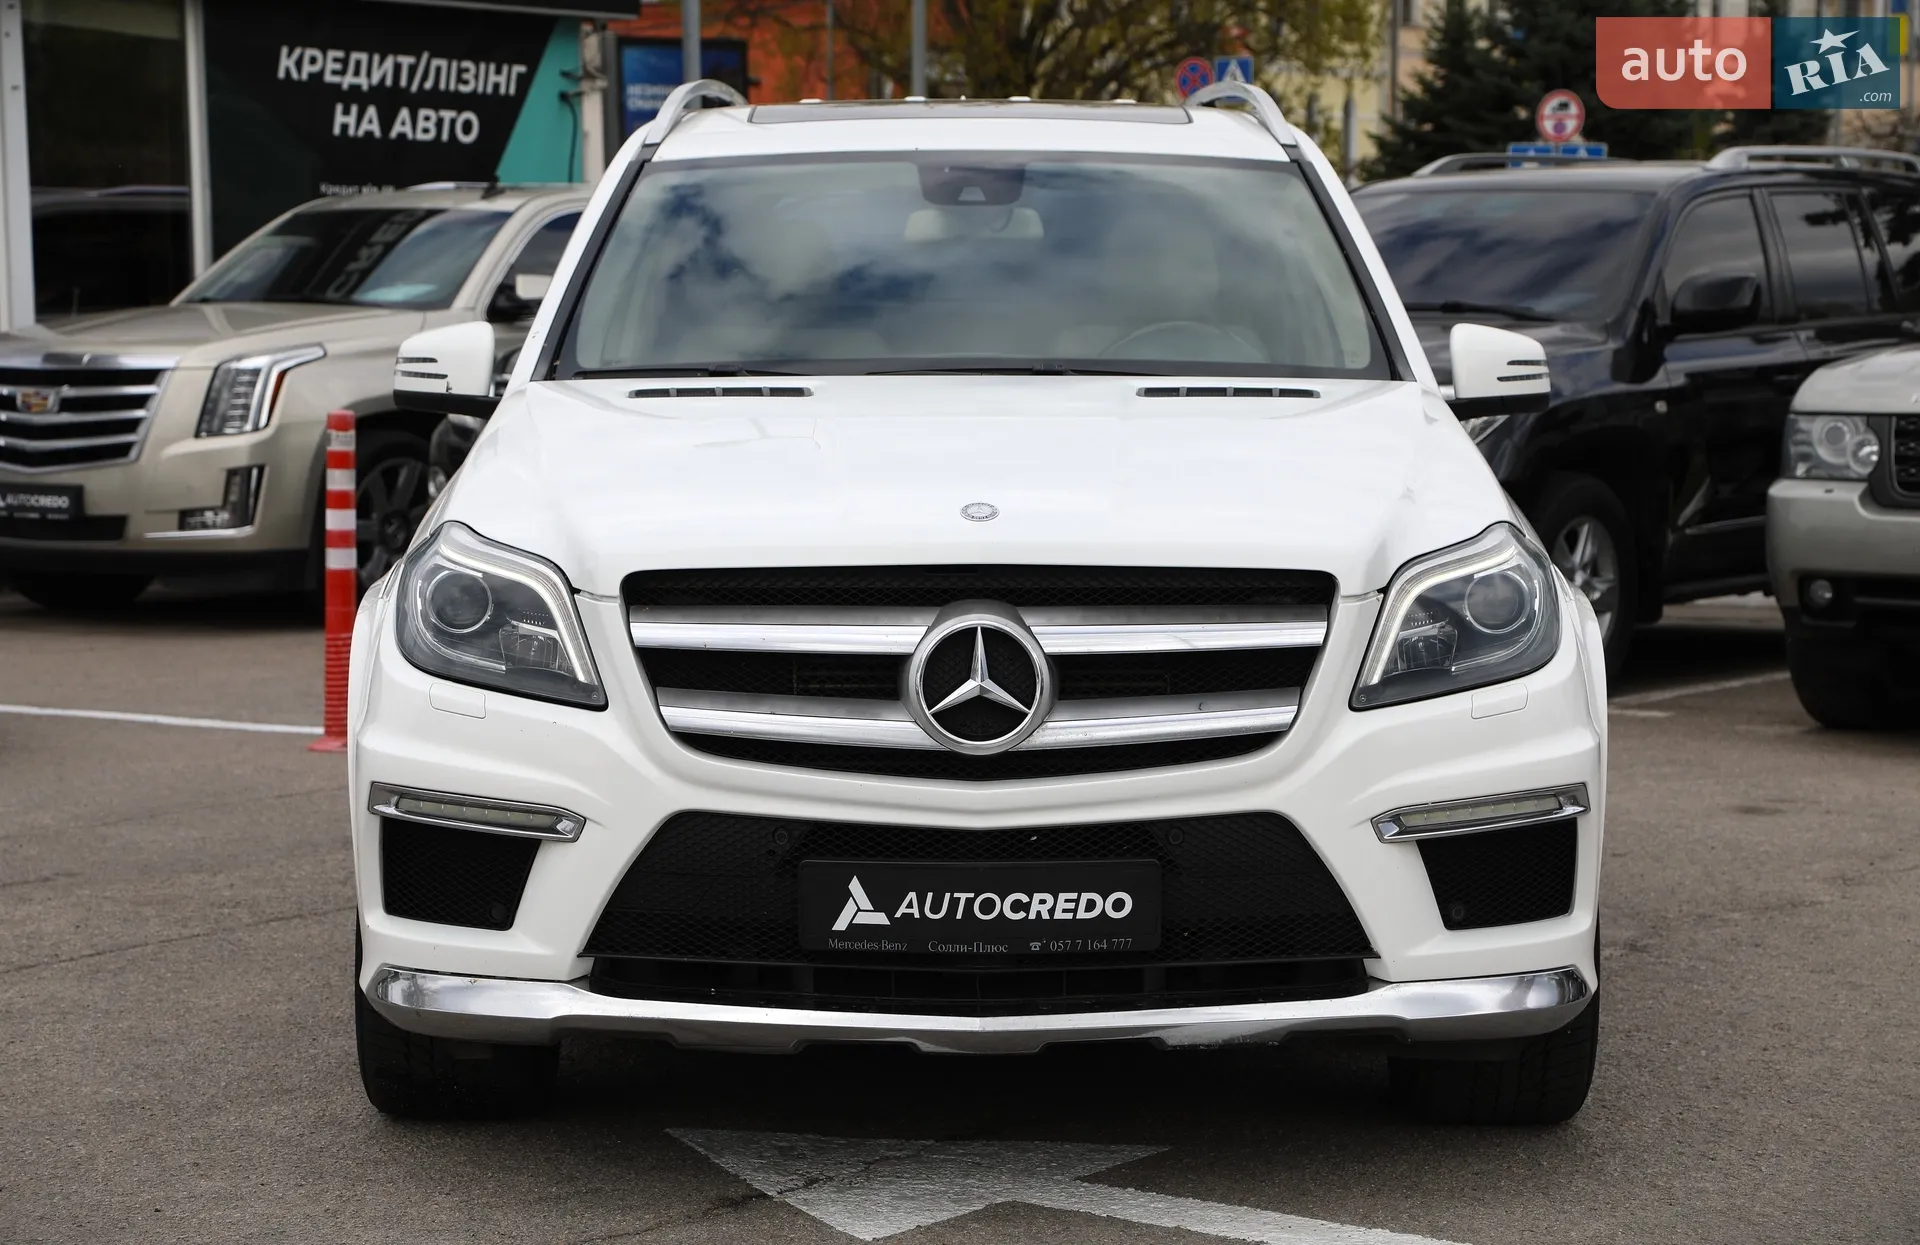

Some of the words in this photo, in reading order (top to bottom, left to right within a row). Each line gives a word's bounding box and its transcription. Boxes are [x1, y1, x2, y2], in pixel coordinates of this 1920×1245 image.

[277, 46, 527, 97] КРЕДИТ/ЛІЗІНГ
[332, 103, 380, 140] НА
[389, 107, 479, 144] АВТО
[894, 891, 1133, 920] AUTOCREDO
[828, 938, 908, 951] Mercedes-Benz
[928, 940, 1009, 953] Солли-Плюс
[1050, 940, 1072, 951] 057
[1076, 940, 1082, 951] 7
[1087, 939, 1107, 950] 164
[1112, 938, 1132, 950] 777
